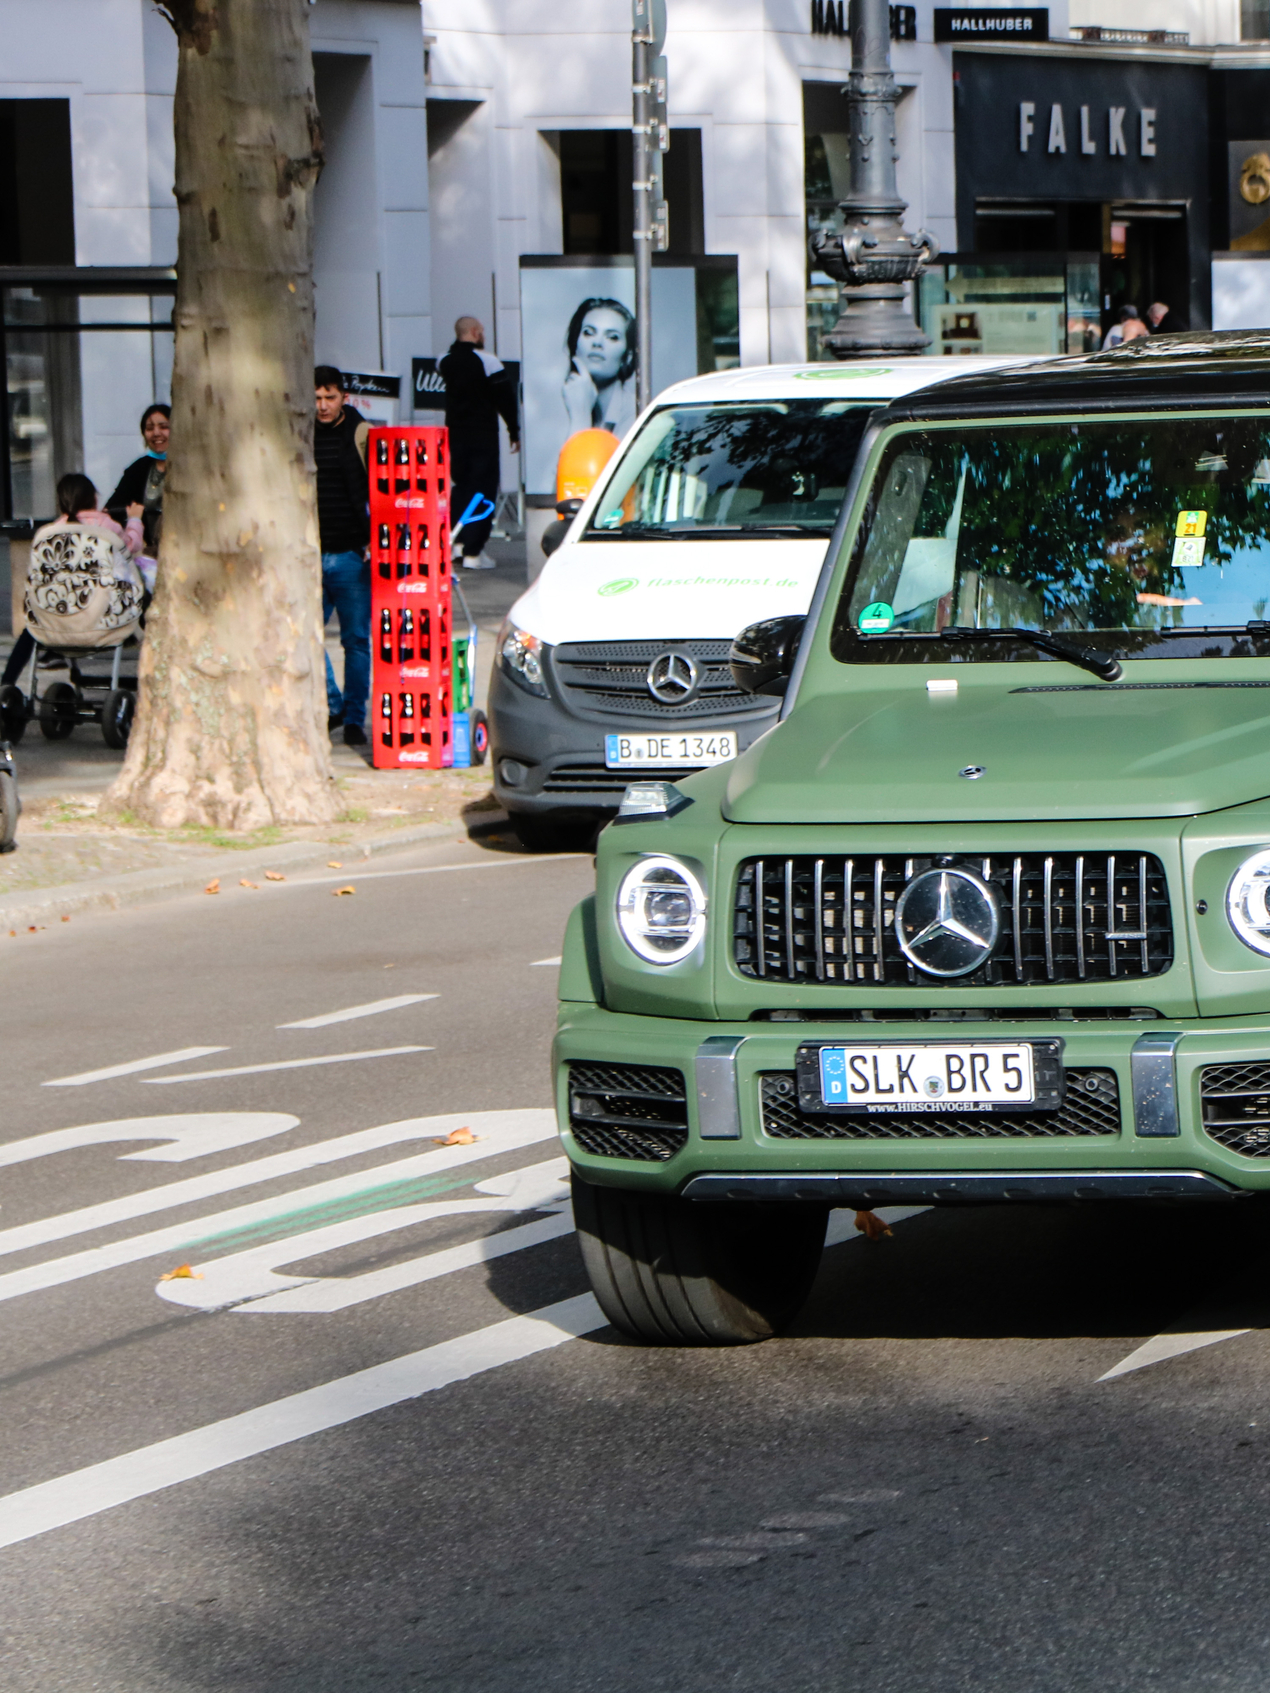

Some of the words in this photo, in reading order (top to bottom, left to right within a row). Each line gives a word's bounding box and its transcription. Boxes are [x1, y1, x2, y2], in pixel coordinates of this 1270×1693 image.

[951, 17, 1033, 31] HALLHUBER
[1019, 102, 1157, 157] FALKE
[1184, 522, 1197, 533] 21
[647, 576, 799, 588] flaschenpost.de
[871, 603, 883, 618] 4
[620, 739, 632, 758] B
[647, 738, 672, 758] DE
[679, 737, 731, 758] 1348
[850, 1055, 918, 1094] SLK
[945, 1053, 991, 1092] BR
[1002, 1053, 1022, 1092] 5
[831, 1081, 843, 1094] D
[866, 1102, 993, 1113] www.HIRSCHVOGEL.eu
